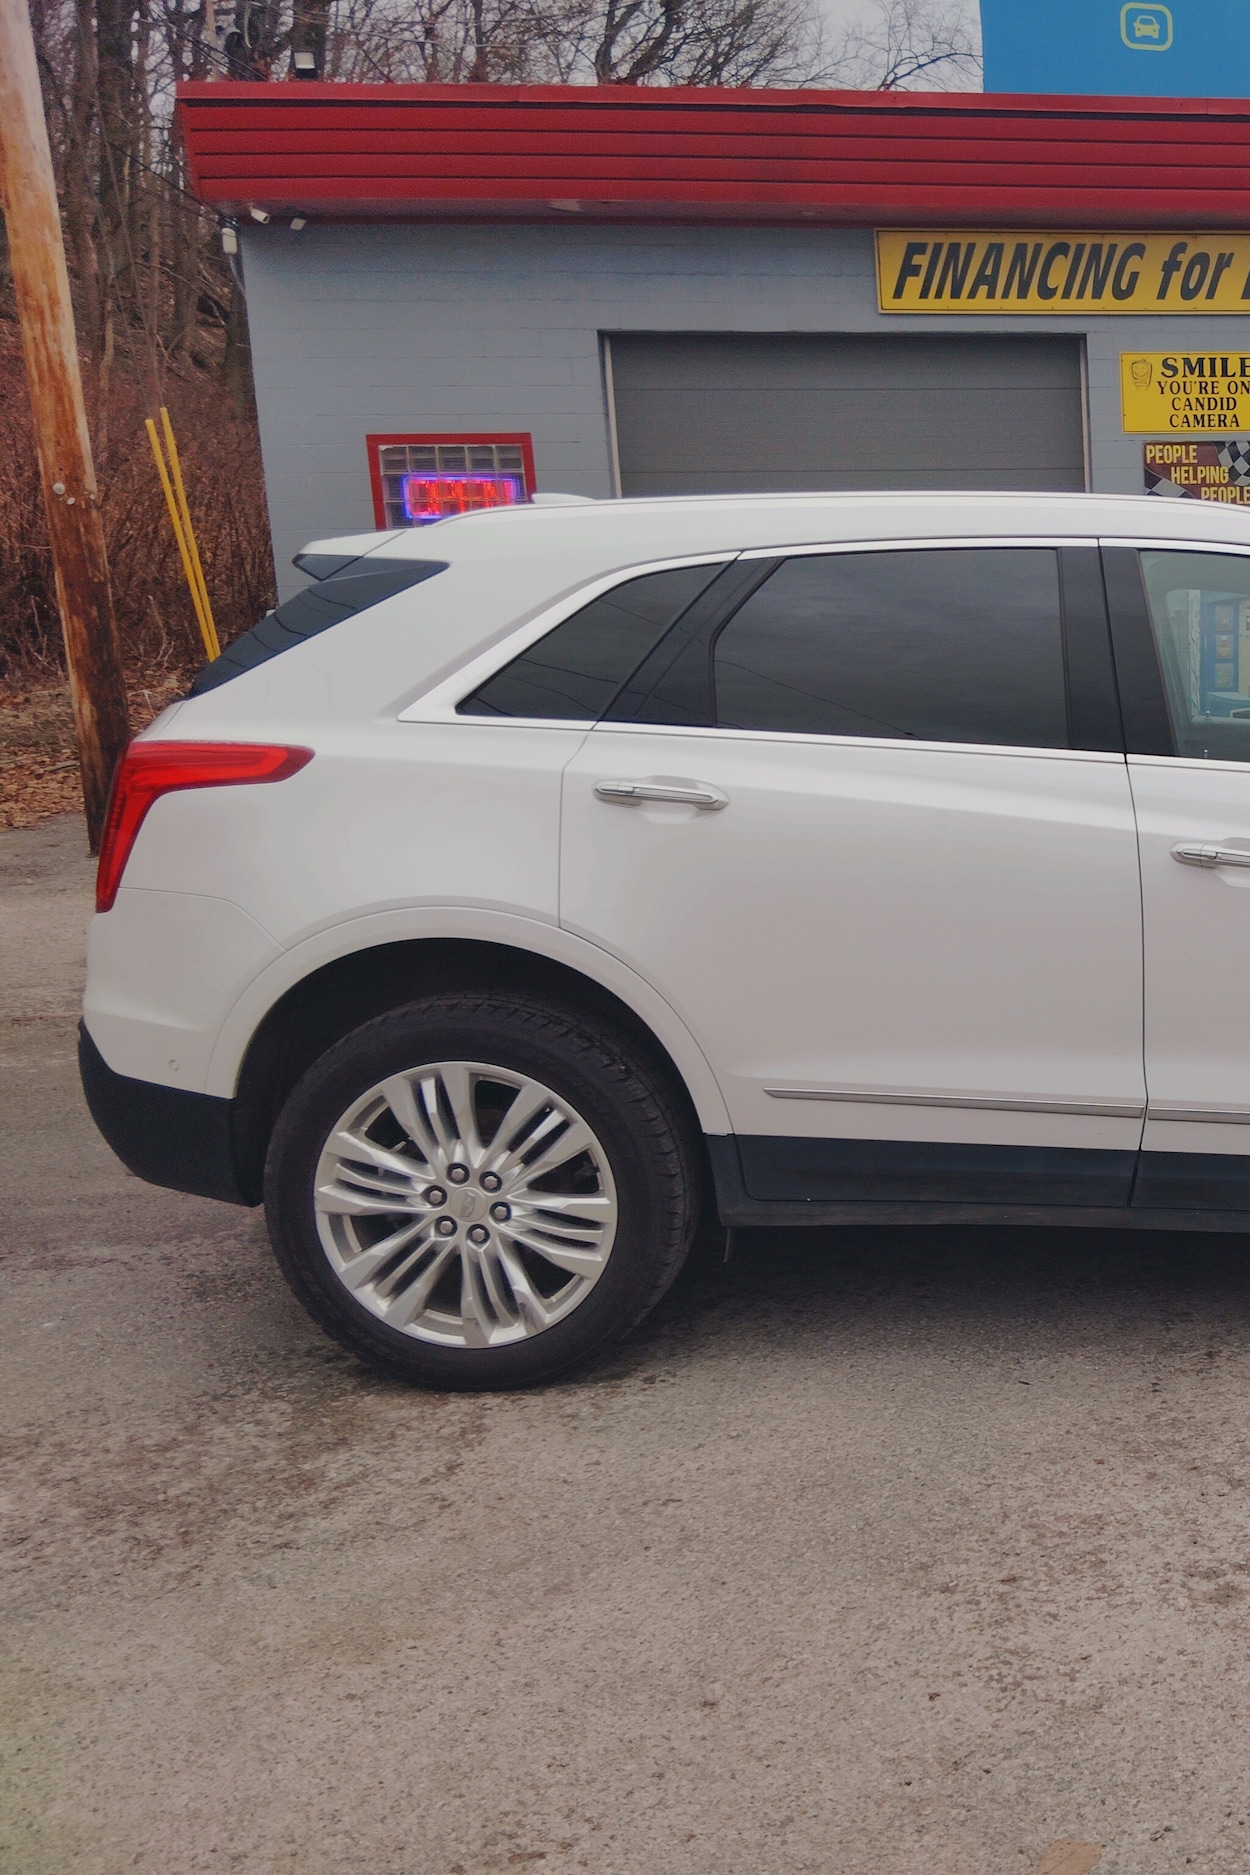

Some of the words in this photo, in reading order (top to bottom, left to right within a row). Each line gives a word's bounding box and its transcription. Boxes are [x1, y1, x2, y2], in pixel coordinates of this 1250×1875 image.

[892, 242, 1146, 300] FINANCING
[1156, 242, 1234, 301] for
[1157, 380, 1219, 395] YOU'RE
[1227, 380, 1250, 395] ON
[1171, 396, 1237, 411] CANDID
[1169, 413, 1240, 428] CAMERA
[1146, 444, 1198, 464] PEOPLE
[1171, 466, 1229, 484] HELPING
